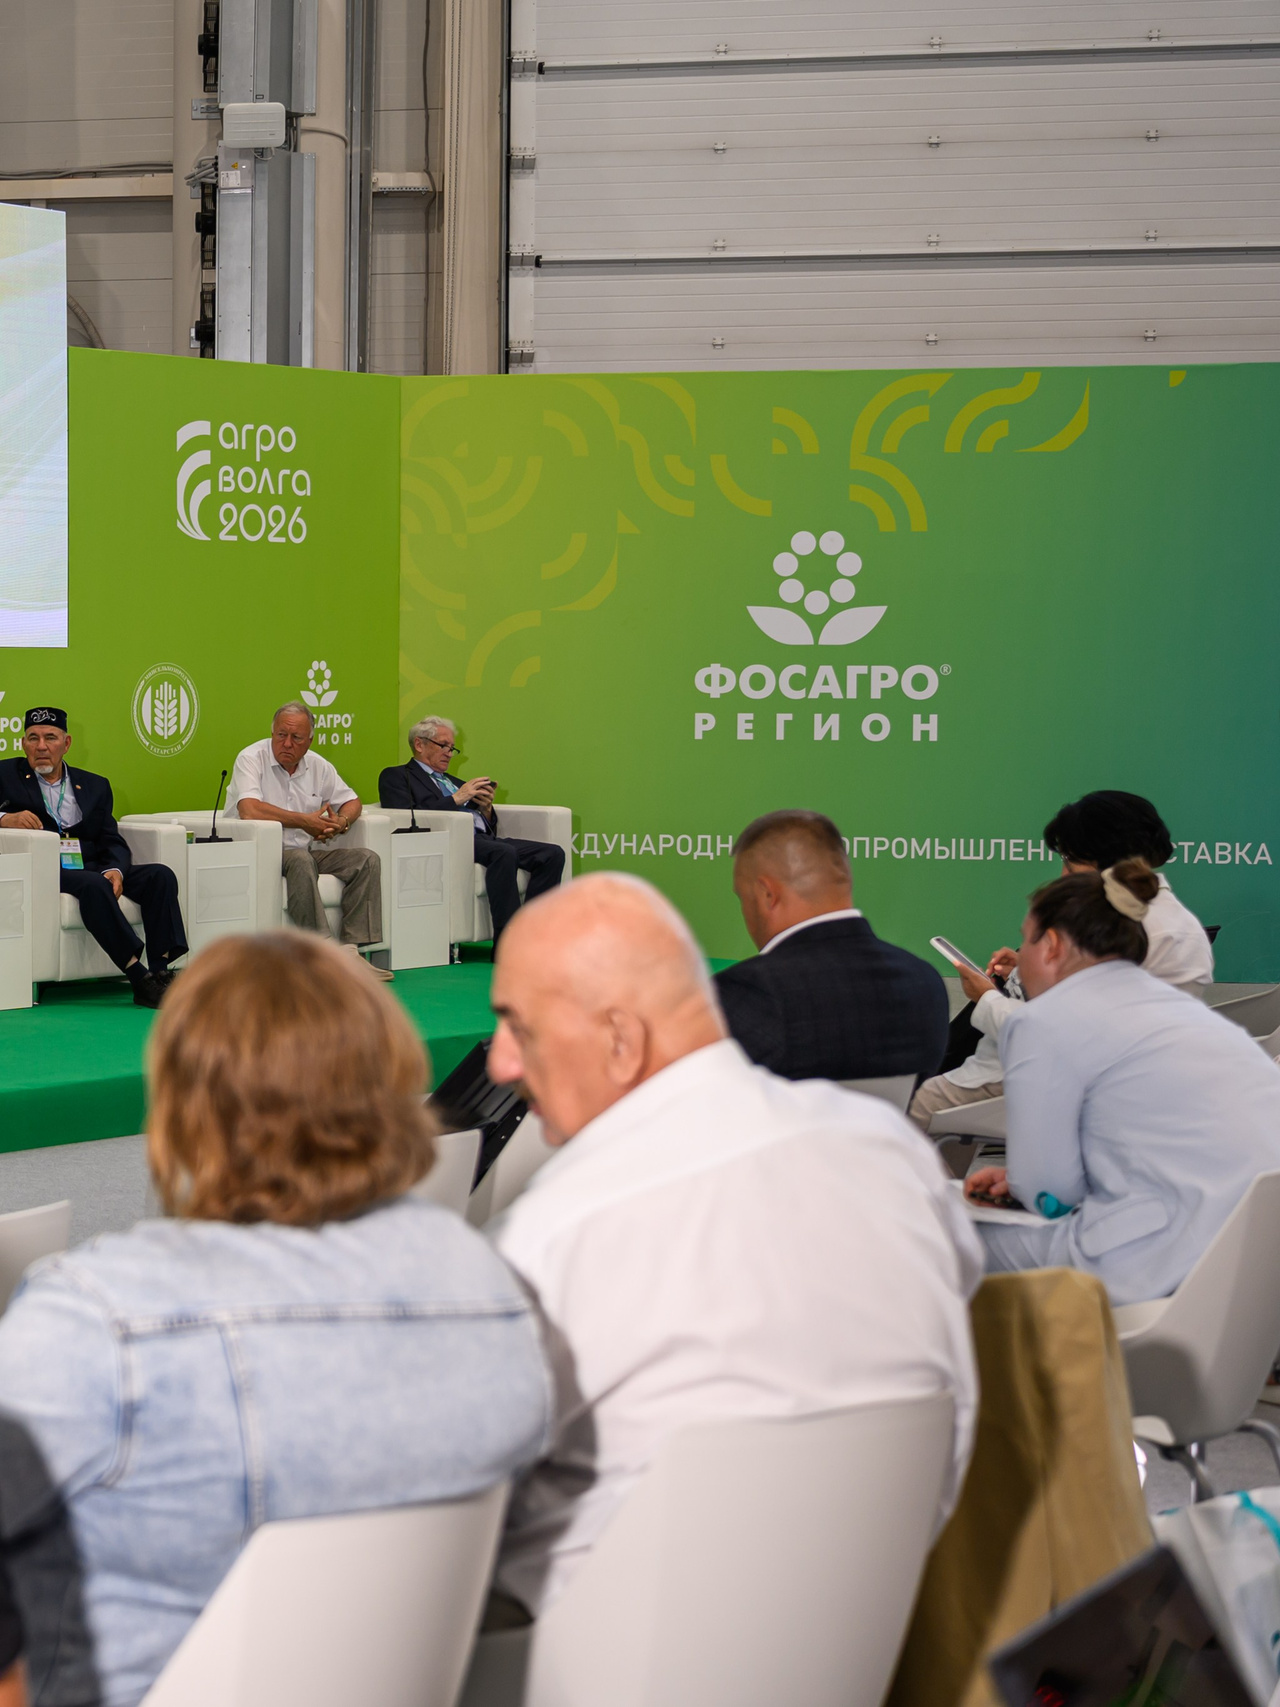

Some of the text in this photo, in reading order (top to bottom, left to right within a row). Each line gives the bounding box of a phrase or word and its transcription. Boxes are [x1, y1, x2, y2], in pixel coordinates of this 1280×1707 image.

[218, 502, 307, 544] 2026
[313, 713, 352, 729] АГРО
[694, 712, 939, 742] РЕГИОН
[318, 732, 352, 745] ИОН
[572, 832, 1273, 866] ДУНАРОДН ПРОМЫШЛЕН ТАВКА
